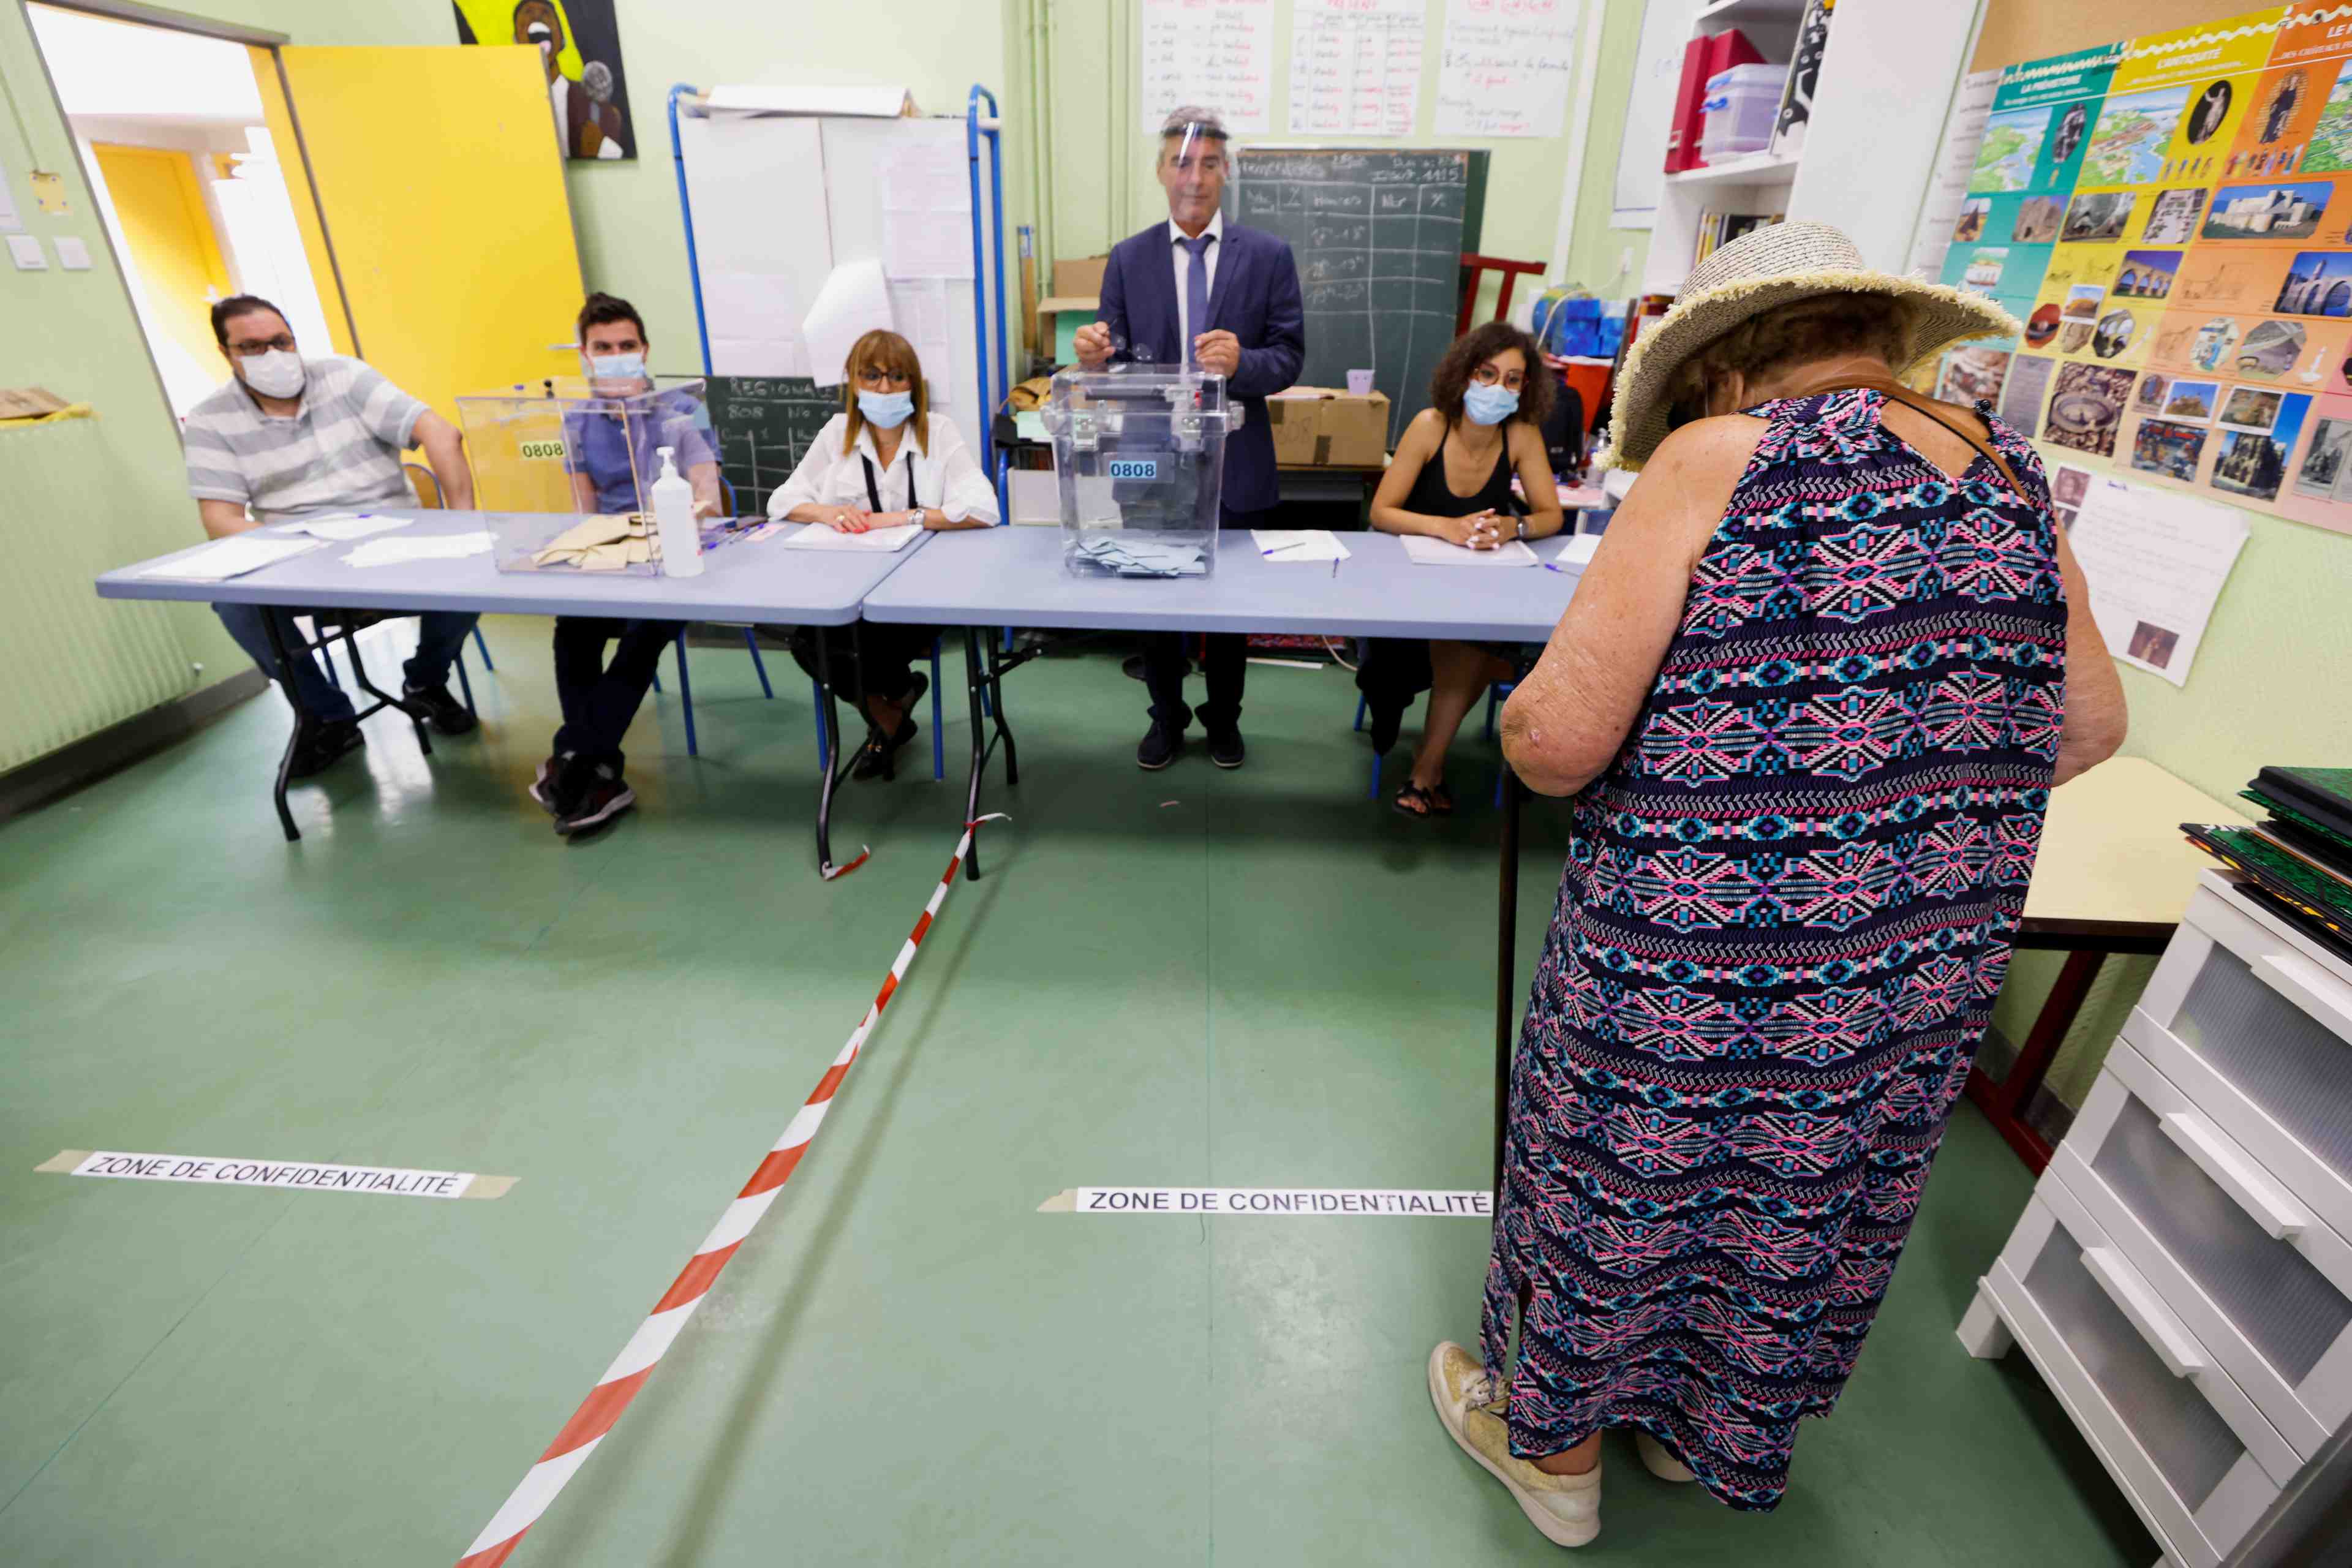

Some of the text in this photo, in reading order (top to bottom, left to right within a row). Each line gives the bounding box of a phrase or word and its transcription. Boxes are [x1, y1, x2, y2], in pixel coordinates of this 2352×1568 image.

[2326, 24, 2347, 38] LE
[522, 442, 564, 458] 0808
[1110, 463, 1155, 477] 0808
[87, 1156, 459, 1194] ZONE DE CONFIDENTIALITÉ
[1089, 1191, 1491, 1213] ZONE DE CONFIDENTIALITÉ
